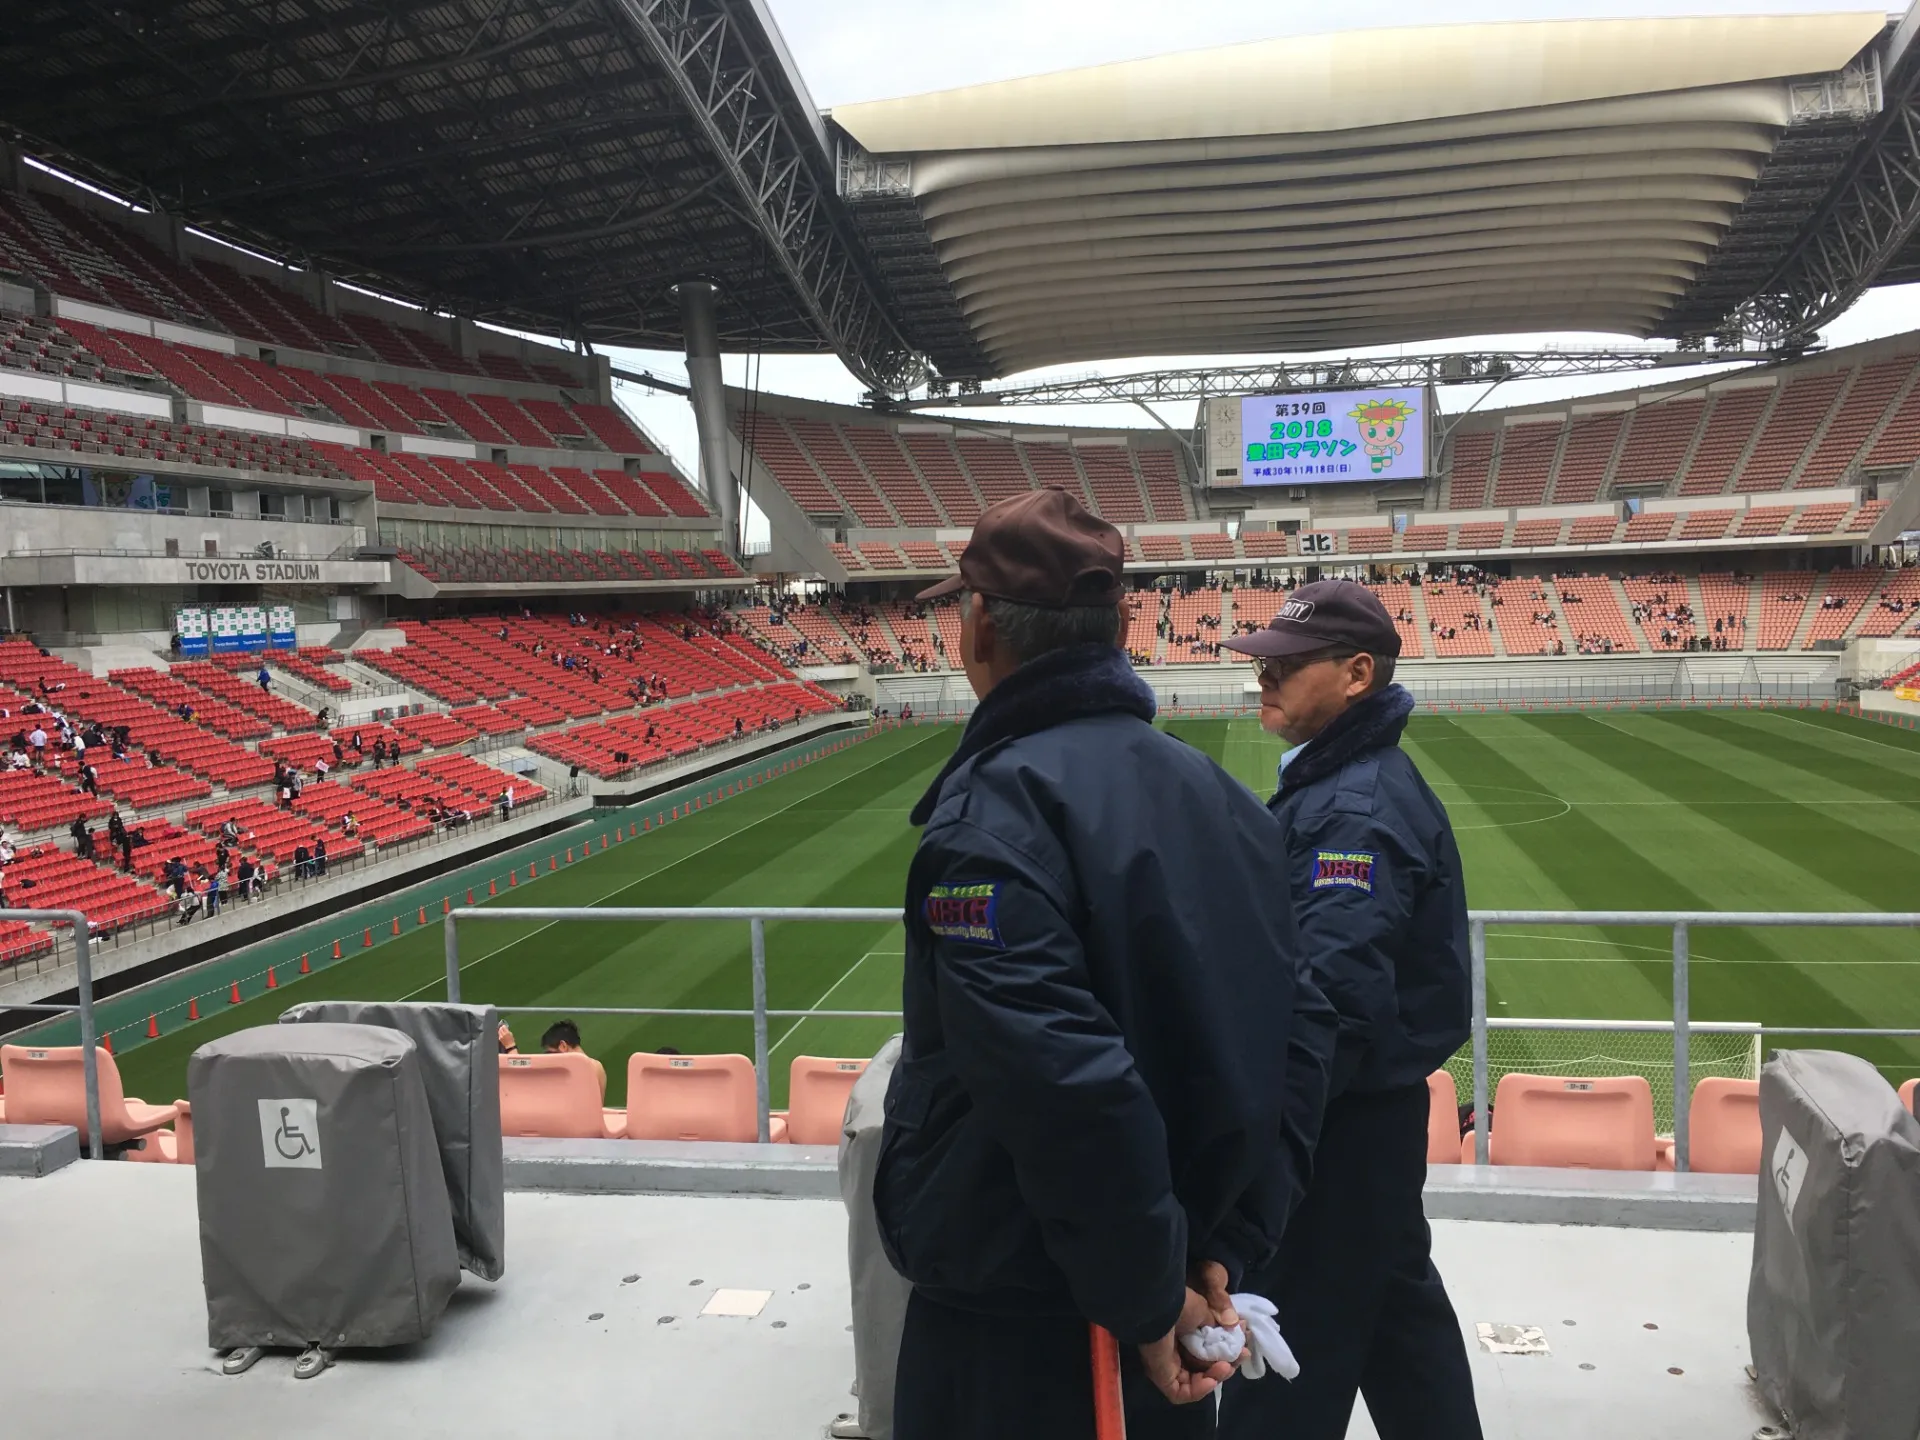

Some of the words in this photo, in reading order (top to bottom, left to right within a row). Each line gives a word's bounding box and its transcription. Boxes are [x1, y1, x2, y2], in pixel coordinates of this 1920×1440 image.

[1275, 402, 1326, 417] 第39回
[1269, 419, 1333, 439] 2018
[1246, 439, 1357, 461] 豊田マラソン
[1302, 534, 1330, 552] 北
[185, 562, 250, 580] TOYOTA
[256, 563, 320, 580] STADIUM
[1316, 860, 1372, 881] MSG
